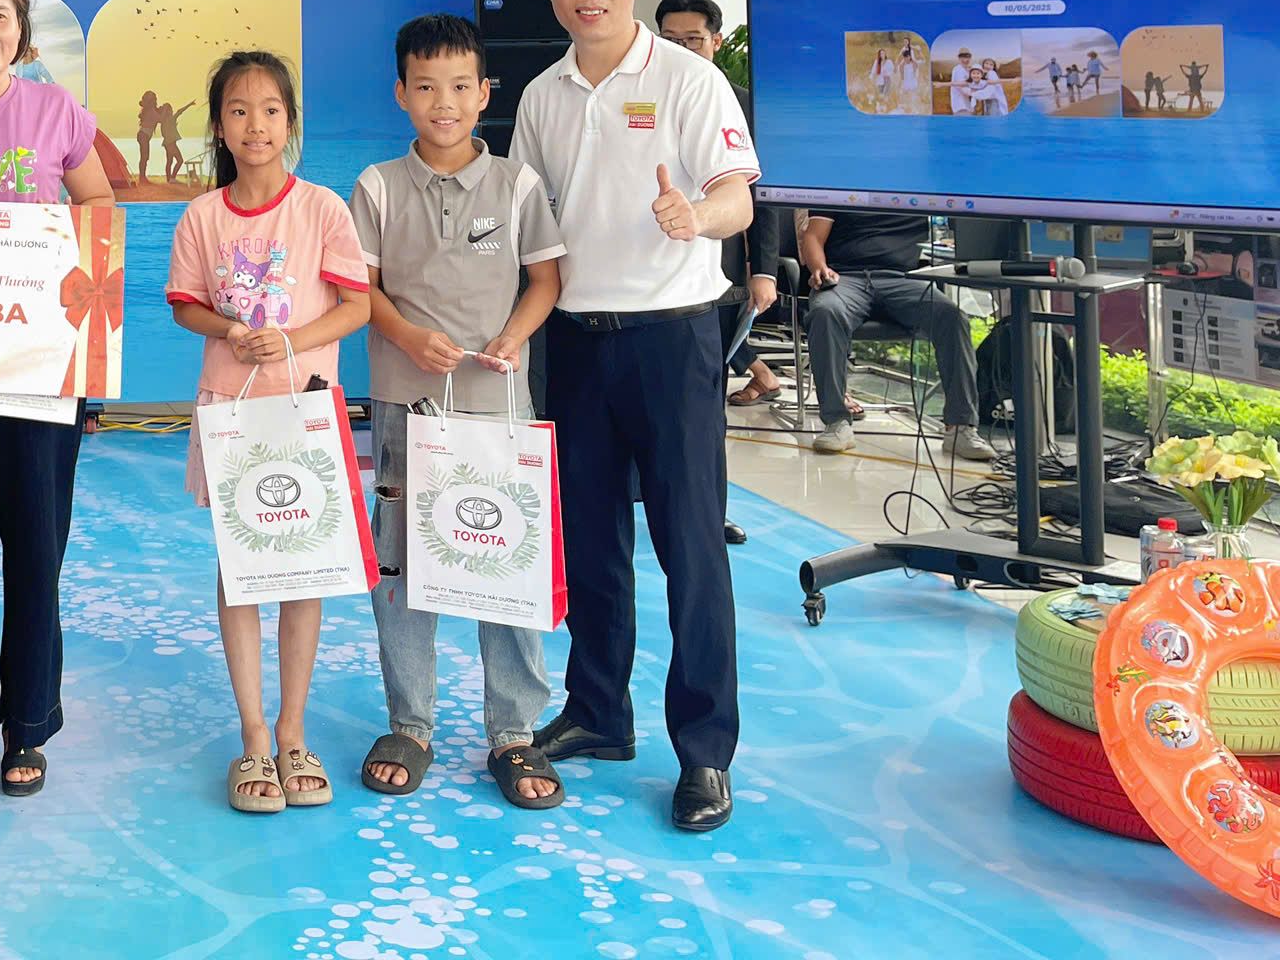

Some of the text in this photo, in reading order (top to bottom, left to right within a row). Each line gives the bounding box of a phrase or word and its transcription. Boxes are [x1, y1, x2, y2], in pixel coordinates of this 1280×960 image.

[1004, 3, 1051, 13] 10/05/2025
[473, 217, 496, 230] NIKE
[14, 239, 49, 249] DƯƠNG
[423, 443, 446, 451] TOYOTA
[256, 508, 310, 524] TOYOTA
[452, 529, 507, 547] TOYOTA
[423, 584, 439, 592] CÔNG
[464, 591, 487, 599] TOYOTA
